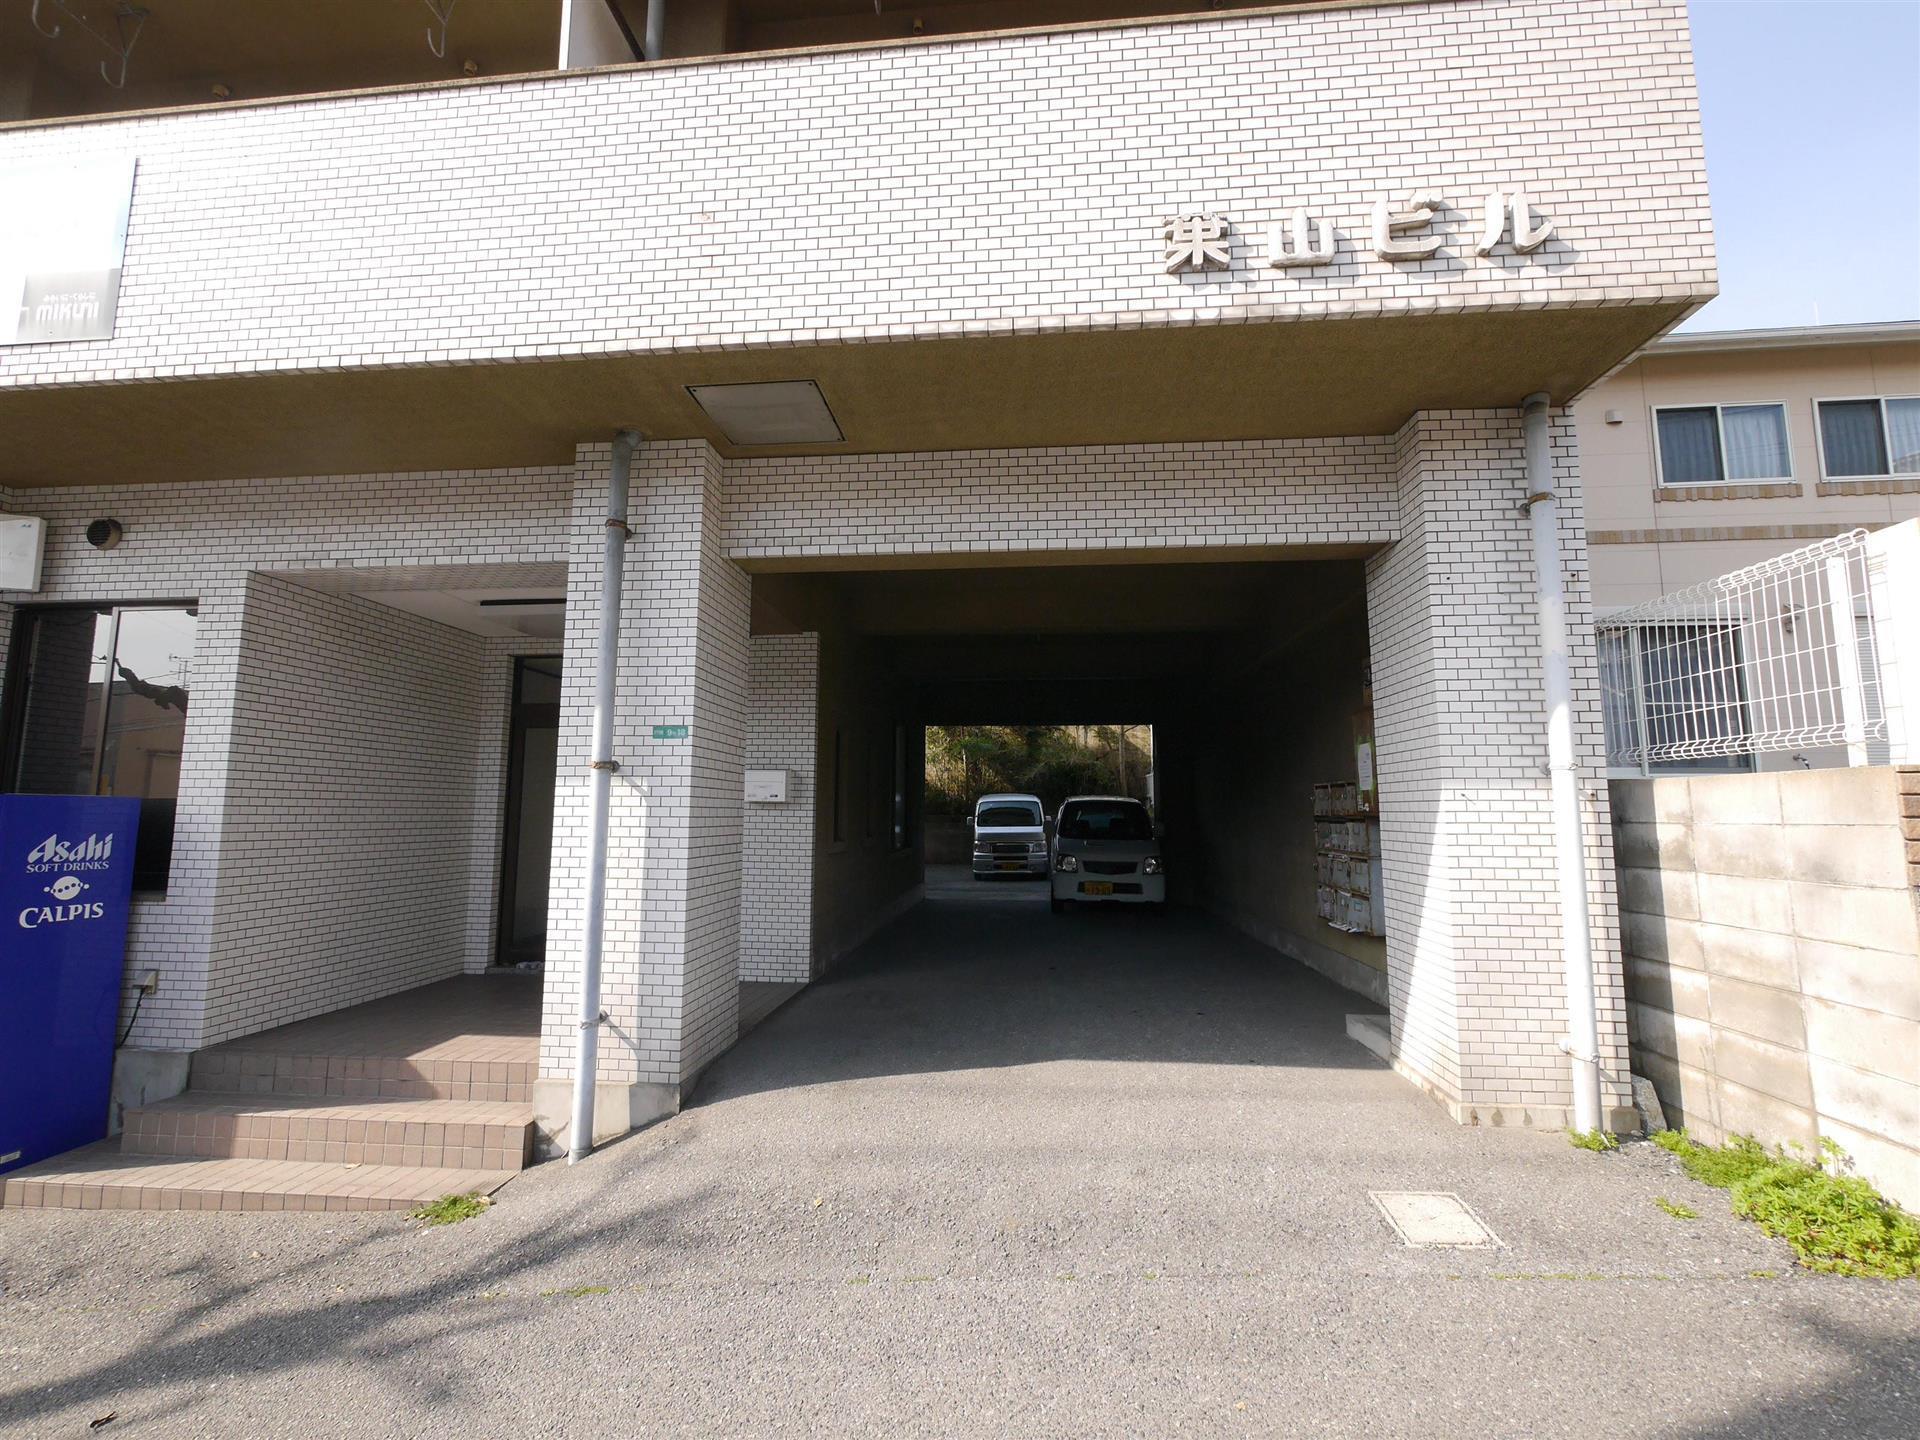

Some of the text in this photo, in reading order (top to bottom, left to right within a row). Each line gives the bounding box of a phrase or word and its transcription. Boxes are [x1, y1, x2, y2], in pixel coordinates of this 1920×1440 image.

[27, 833, 113, 863] Asahi
[26, 862, 109, 873] SOFT DRINKS
[19, 902, 104, 929] CALPIS
